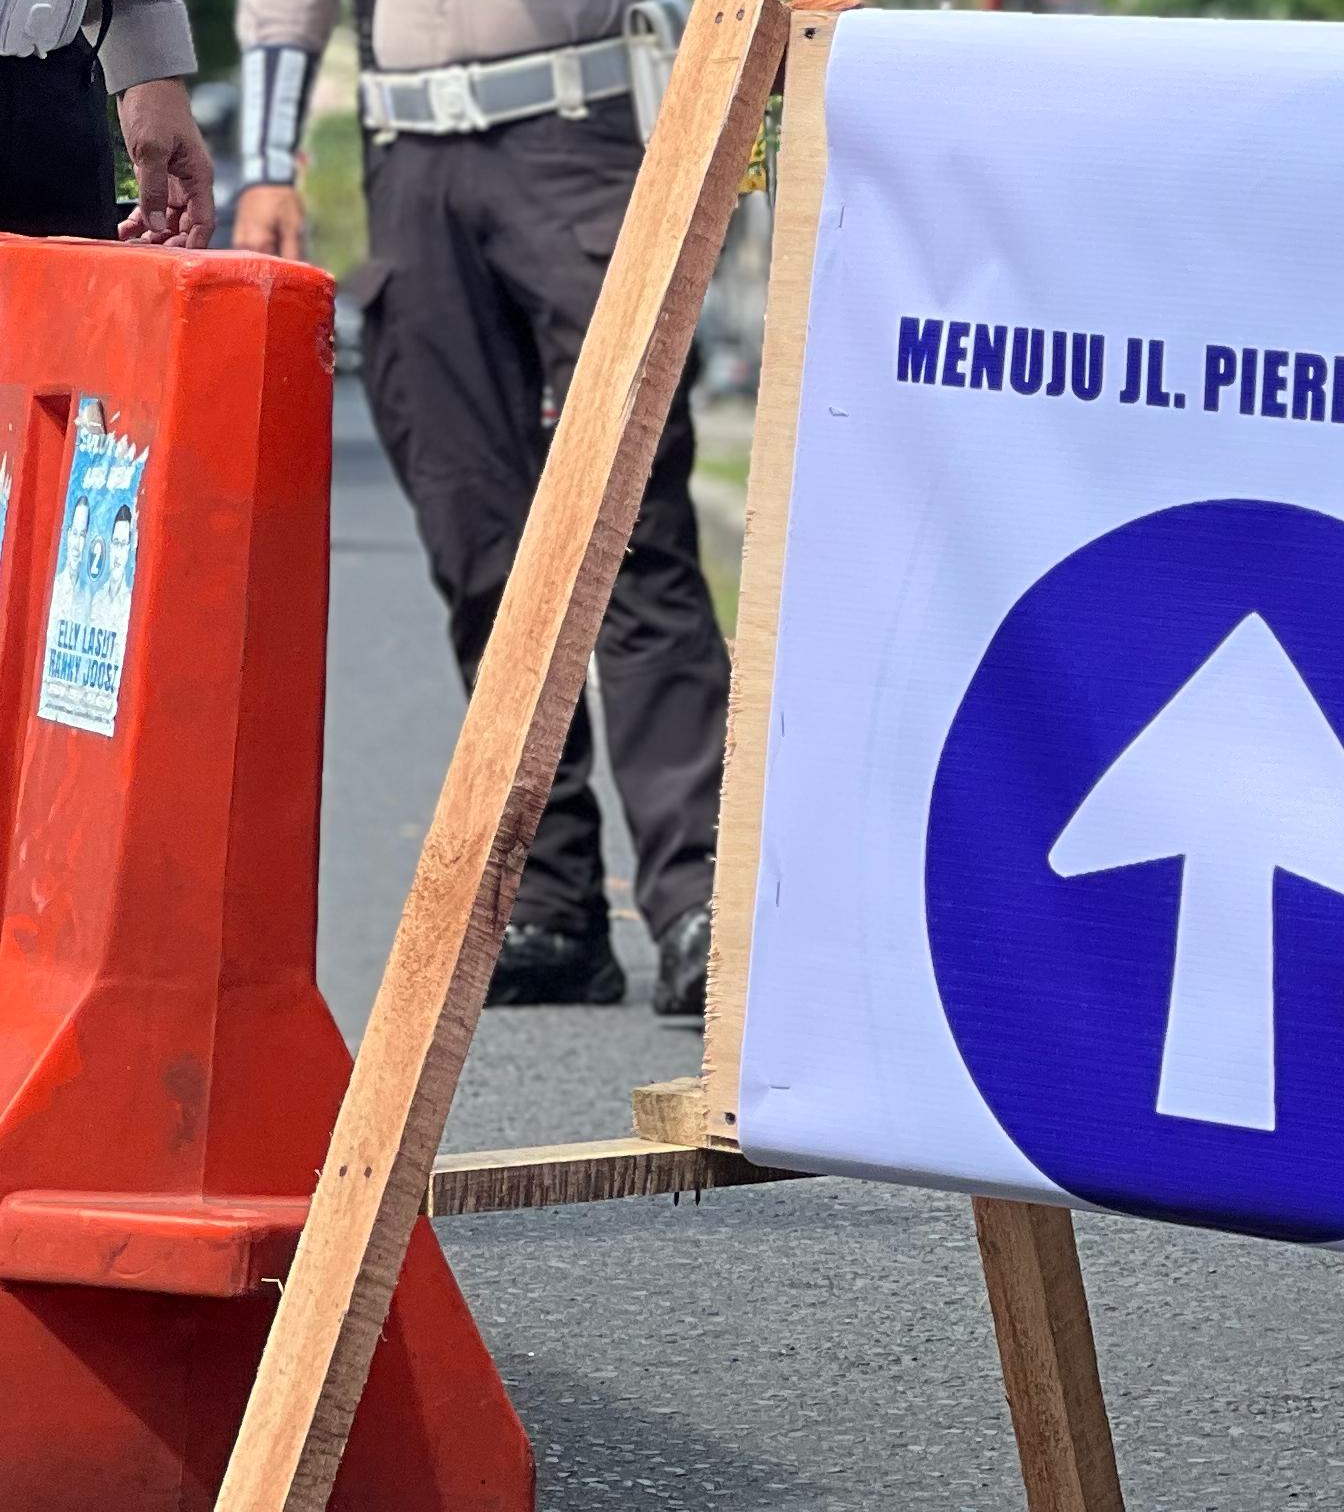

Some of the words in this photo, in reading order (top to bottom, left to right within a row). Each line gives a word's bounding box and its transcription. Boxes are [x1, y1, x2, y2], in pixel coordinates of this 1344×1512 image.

[897, 316, 1106, 403] MENUJU
[1119, 337, 1186, 410] JL.
[90, 541, 103, 574] 2
[58, 619, 81, 650] ELLY
[82, 626, 117, 659] LASUT
